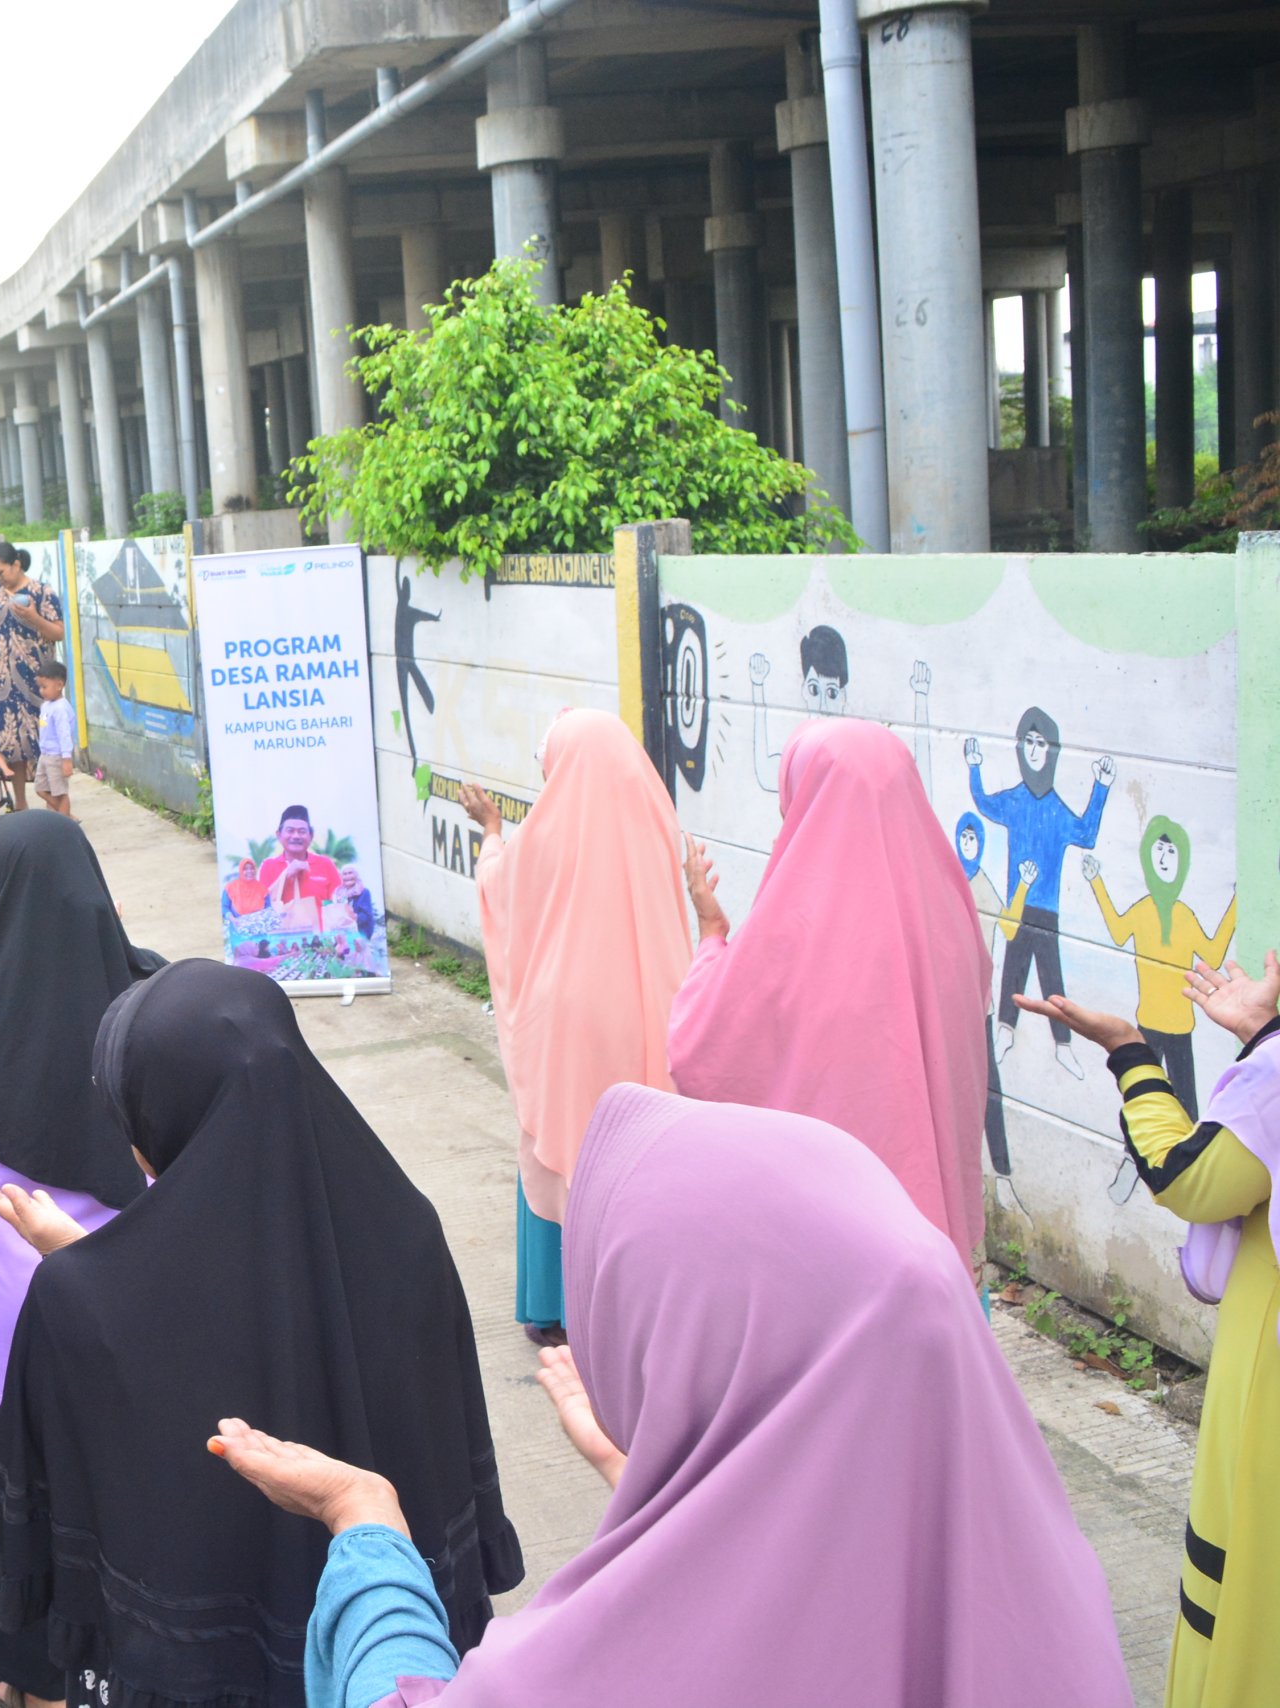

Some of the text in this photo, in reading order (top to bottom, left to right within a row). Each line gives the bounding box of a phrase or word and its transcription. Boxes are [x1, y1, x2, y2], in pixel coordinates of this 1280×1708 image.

[224, 634, 342, 660] PROGRAM
[211, 659, 360, 687] DESA RAMAH
[243, 688, 325, 711] LANSIA
[225, 715, 353, 735] KAMPUNG BAHARI
[254, 735, 327, 751] MARUNDA
